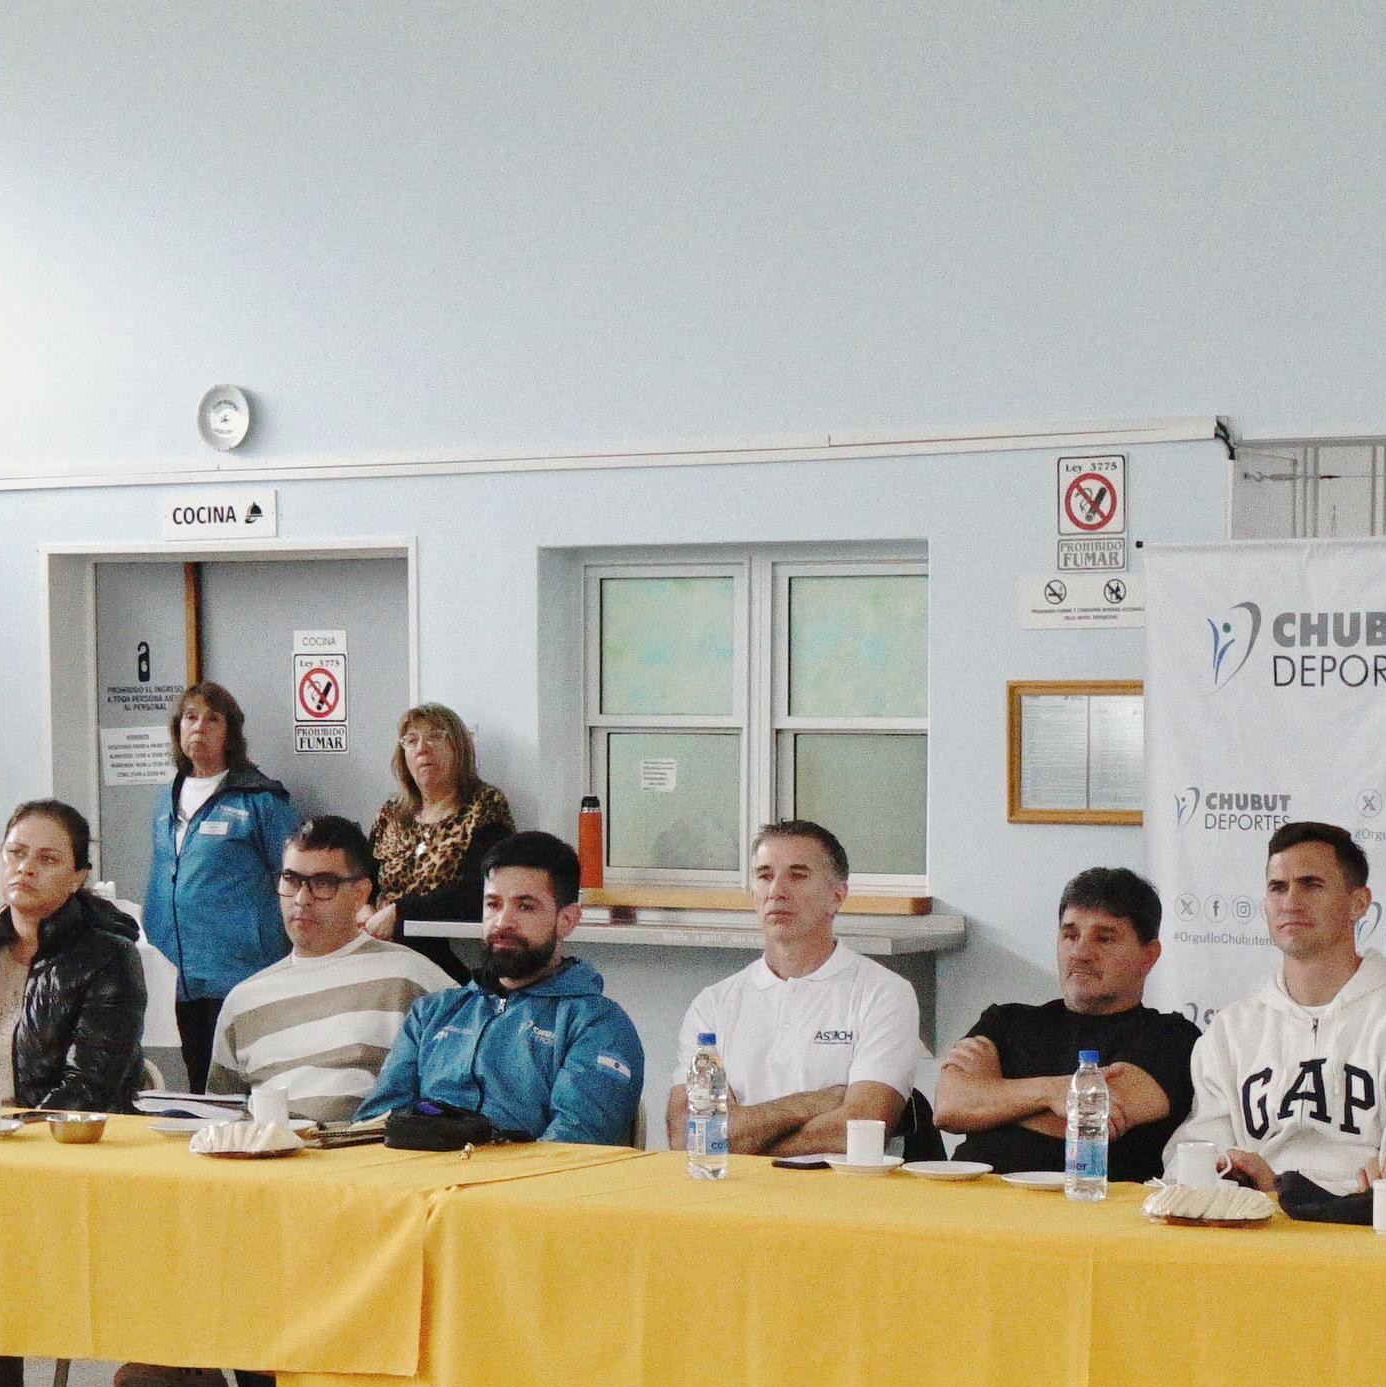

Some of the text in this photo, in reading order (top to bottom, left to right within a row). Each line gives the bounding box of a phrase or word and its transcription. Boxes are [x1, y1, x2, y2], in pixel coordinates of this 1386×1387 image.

[1065, 462, 1117, 473] Ley 3775
[172, 505, 237, 525] COCINA
[1060, 541, 1122, 552] PROHIBIDO
[1063, 551, 1120, 568] FUMAR
[302, 637, 336, 646] COCINA
[297, 728, 344, 736] PROHIBIDO
[300, 737, 343, 749] FUMAR
[1205, 792, 1291, 812] CHUBUT
[1174, 931, 1275, 946] #OrgulloChubuten
[1241, 1057, 1376, 1140] GAP
